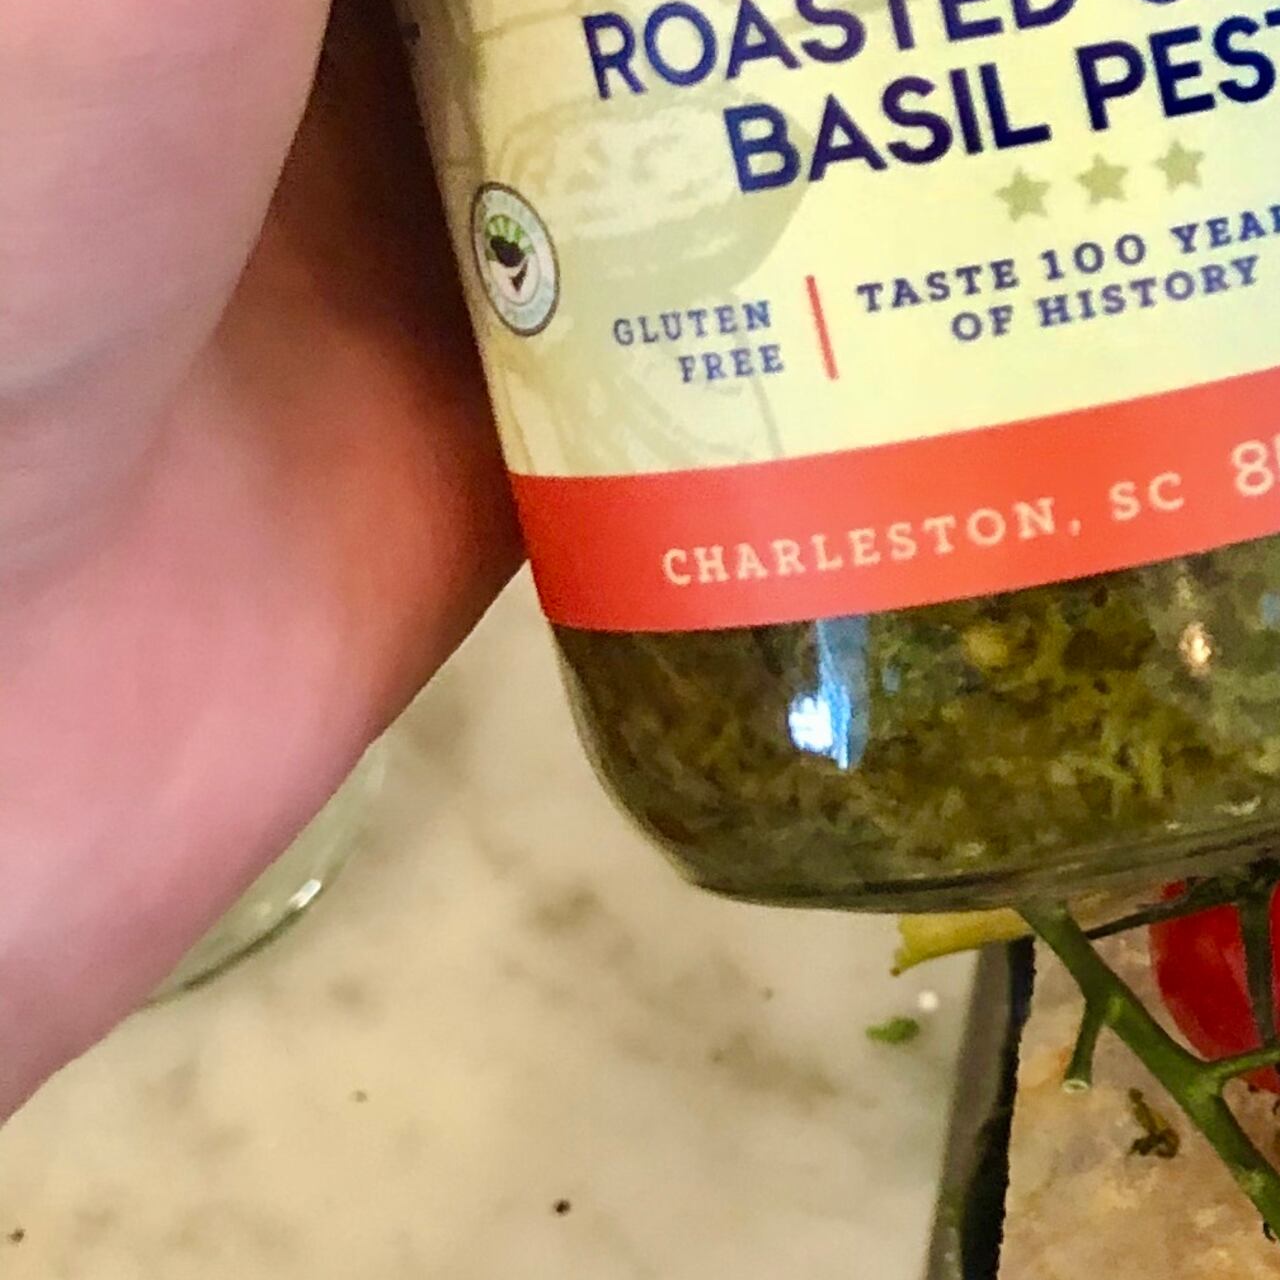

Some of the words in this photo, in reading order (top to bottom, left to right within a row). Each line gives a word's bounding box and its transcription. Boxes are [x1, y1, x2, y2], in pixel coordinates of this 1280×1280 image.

[723, 64, 1051, 193] BASIL
[856, 258, 1019, 313] TASTE
[1041, 234, 1146, 281] 100
[951, 308, 1012, 343] OF
[1034, 255, 1262, 327] HISTORY
[613, 299, 772, 346] GLUTEN
[677, 345, 784, 384] FREE
[663, 498, 1083, 587] CHARLESTON,
[1111, 473, 1186, 520] SC
